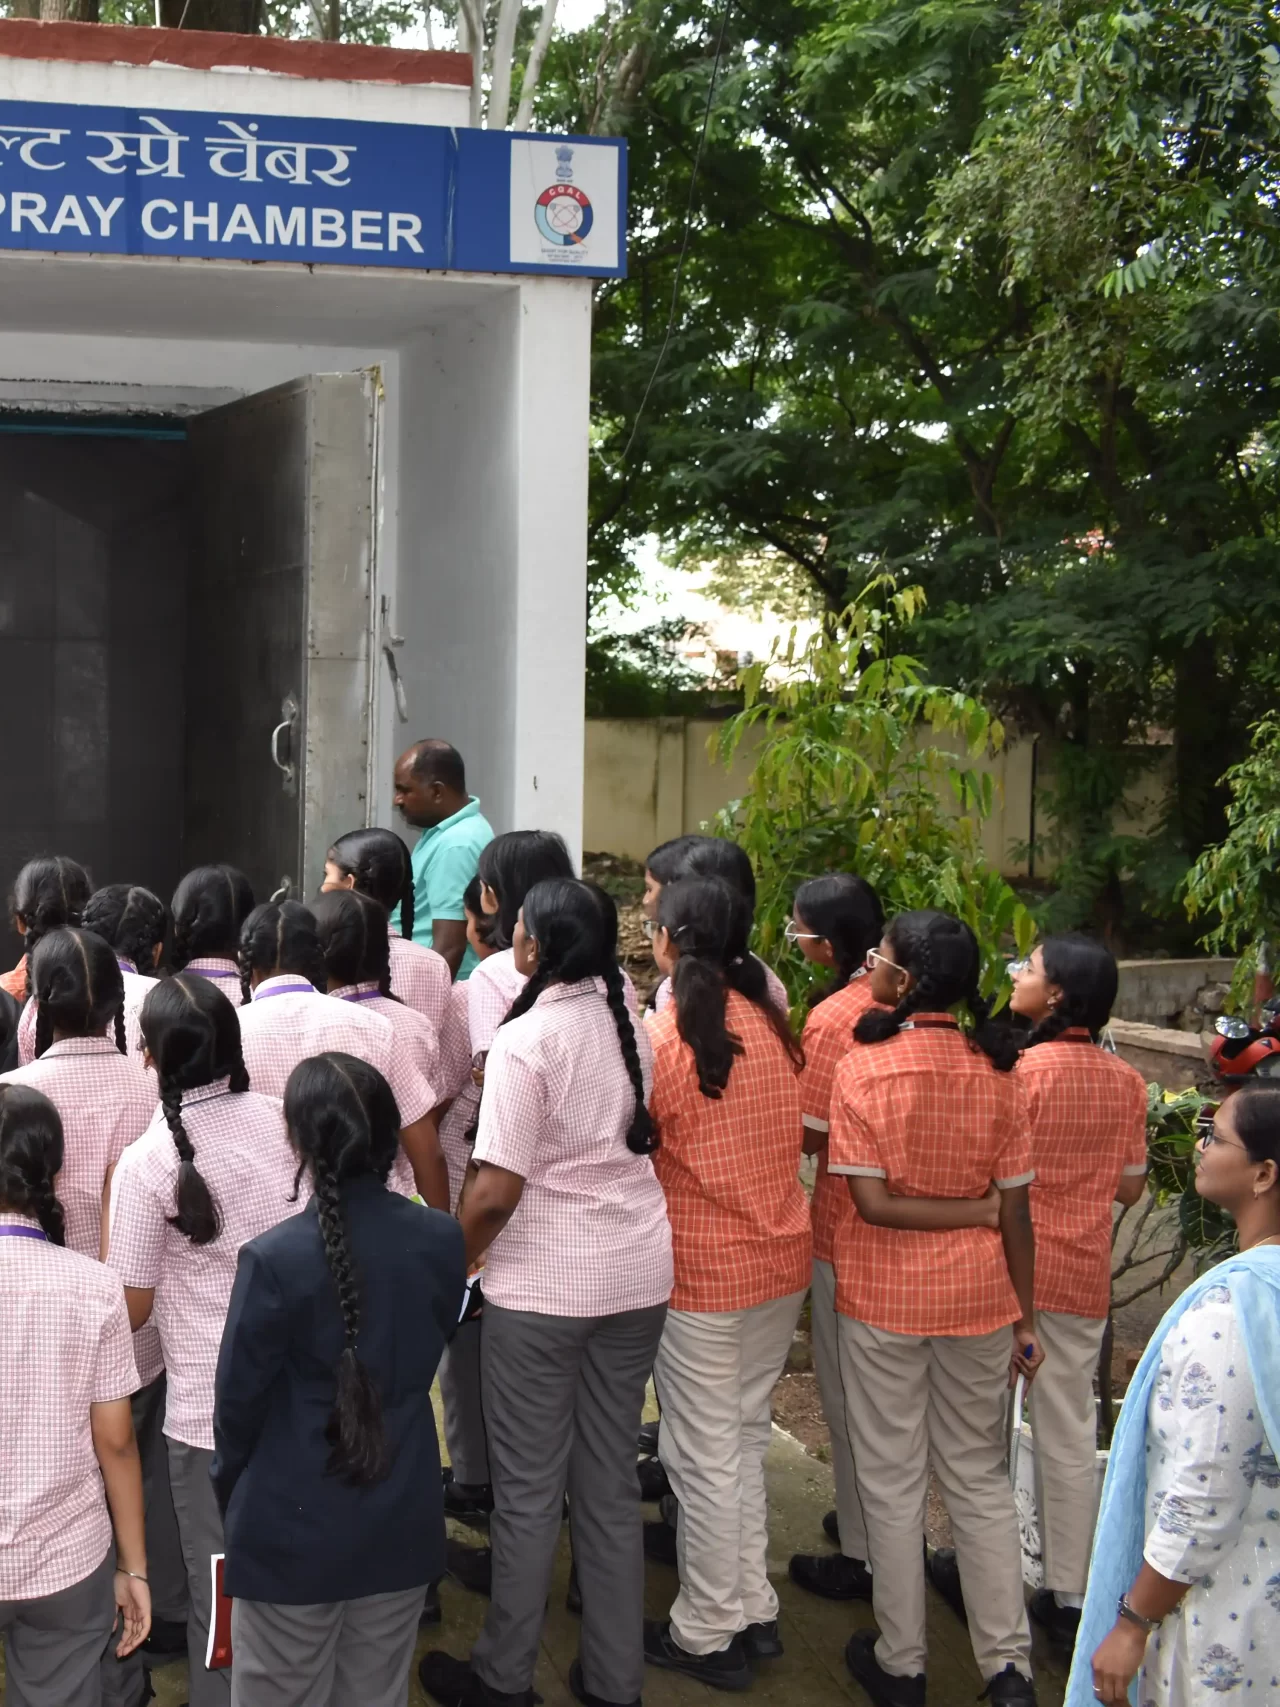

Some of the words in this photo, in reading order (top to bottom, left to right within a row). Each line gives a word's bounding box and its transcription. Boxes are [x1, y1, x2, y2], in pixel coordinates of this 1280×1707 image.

[86, 116, 189, 178] स्प्रे
[204, 120, 357, 187] चेंबर
[140, 199, 424, 253] CHAMBER
